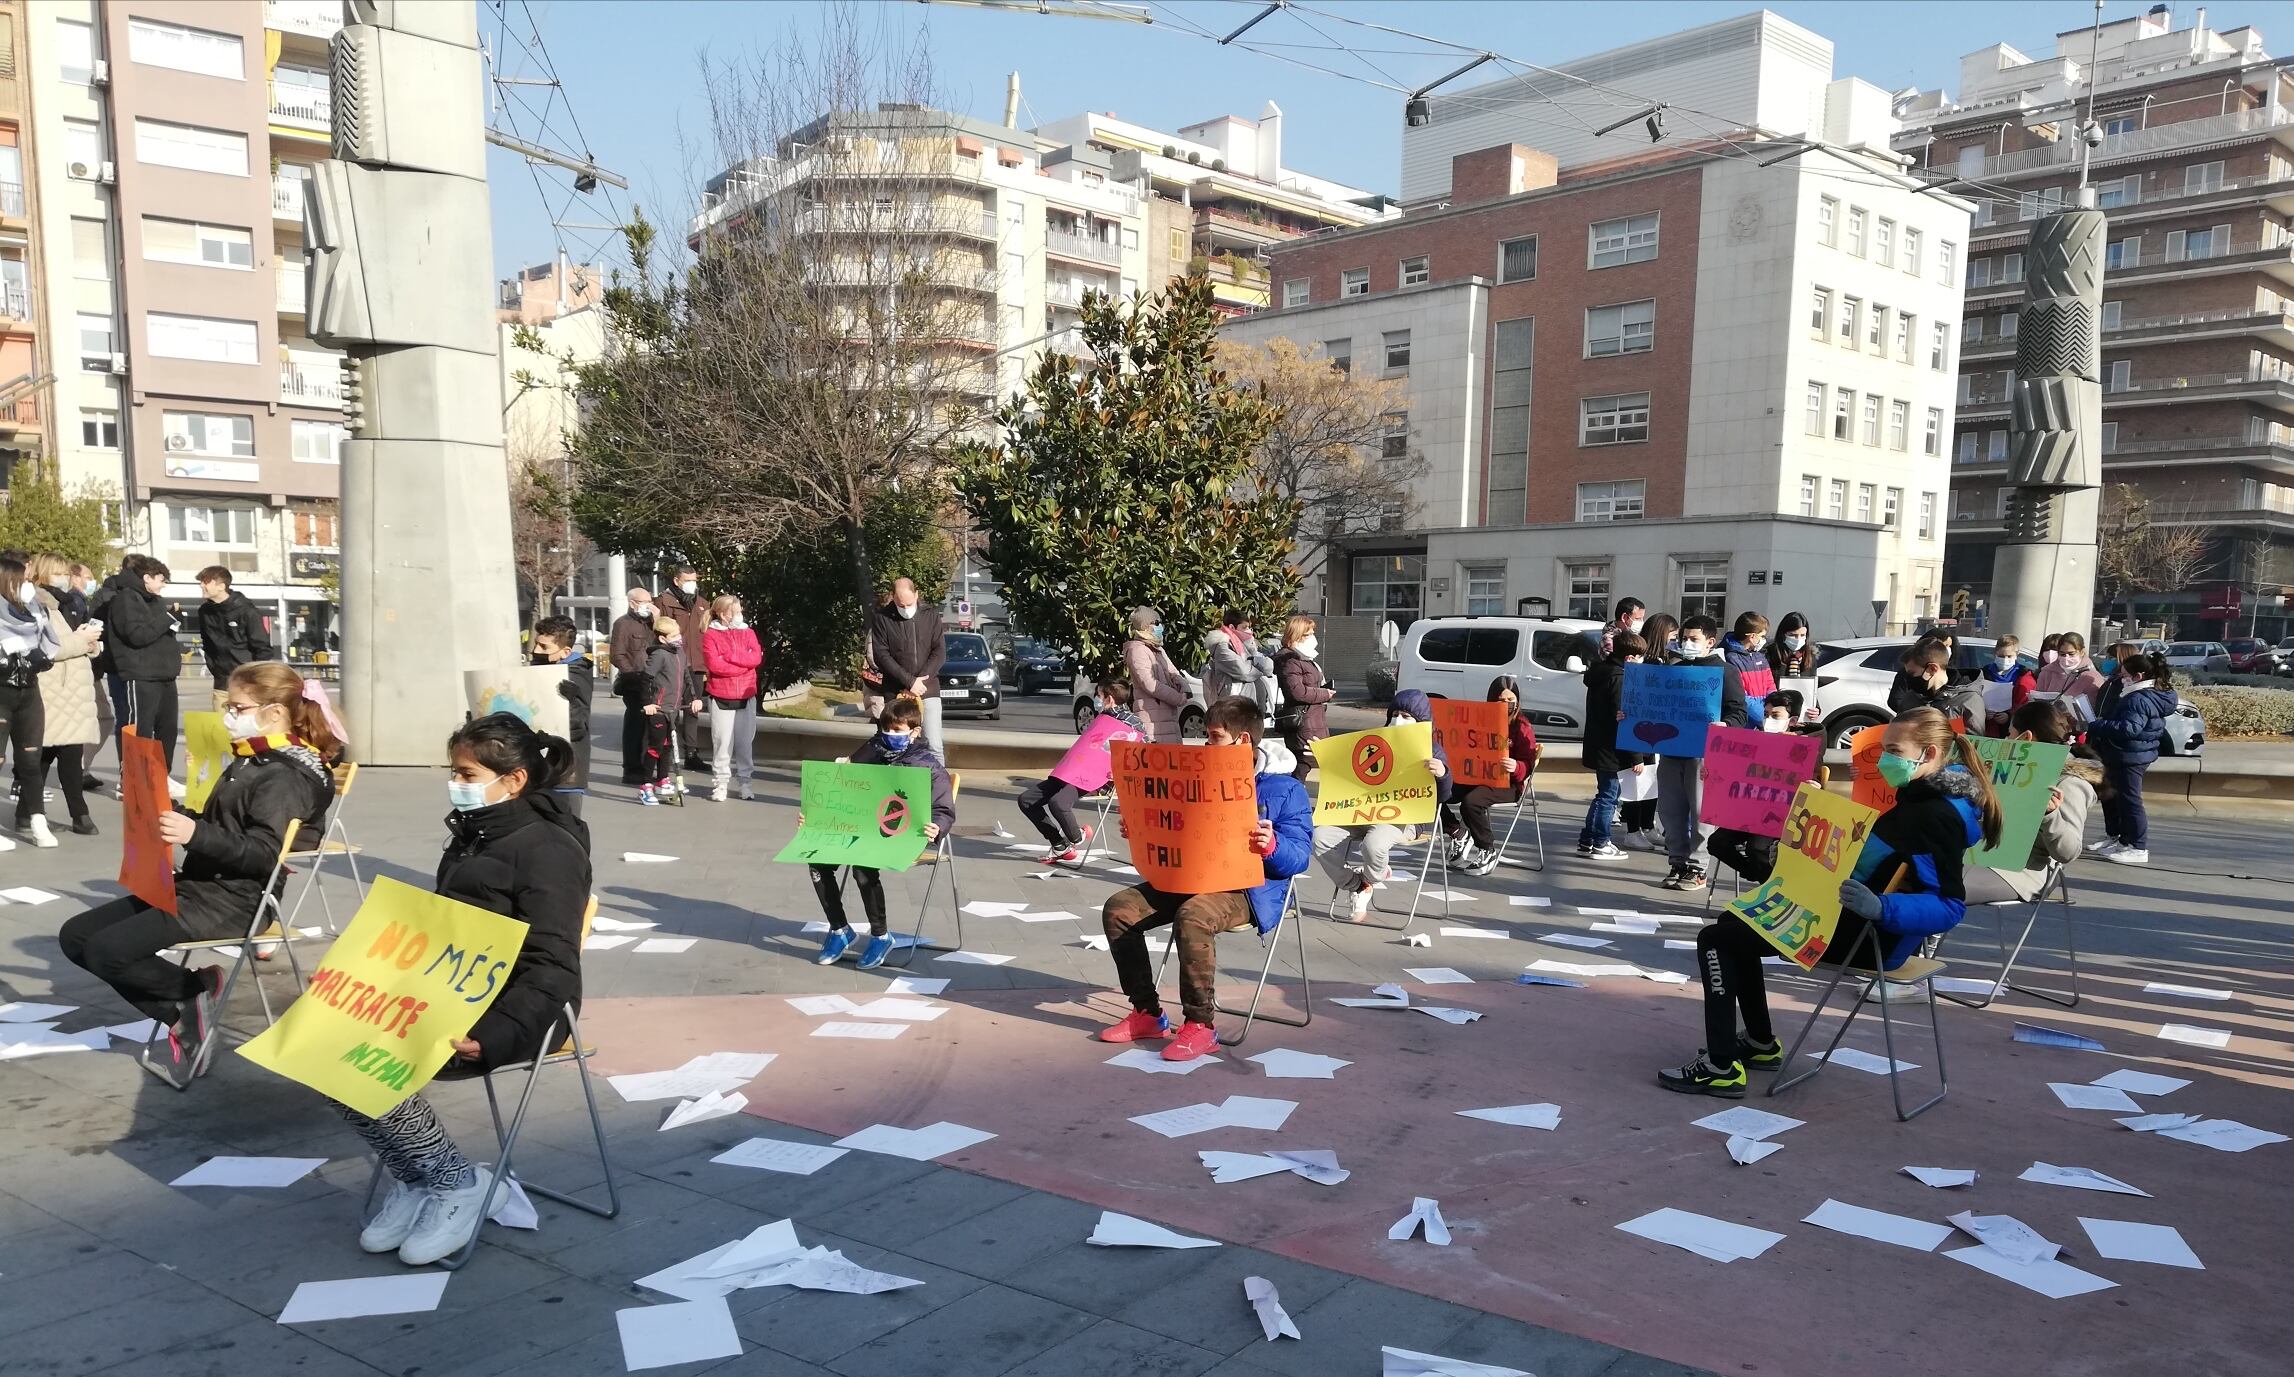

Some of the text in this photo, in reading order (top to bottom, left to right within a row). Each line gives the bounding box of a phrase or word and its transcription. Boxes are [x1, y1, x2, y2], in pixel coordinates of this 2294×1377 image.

[1123, 747, 1206, 772] ESCOLES
[1324, 785, 1434, 810] BOMBES A LES ESCOLES
[1143, 807, 1185, 831] AMB
[1352, 805, 1401, 823] NO
[1780, 791, 1847, 873] ESCOLES
[1146, 842, 1182, 867] PAU
[367, 921, 506, 1003] NO MÉS
[308, 967, 428, 1039] MALTRACTE
[339, 1041, 418, 1092] ANIMAL
